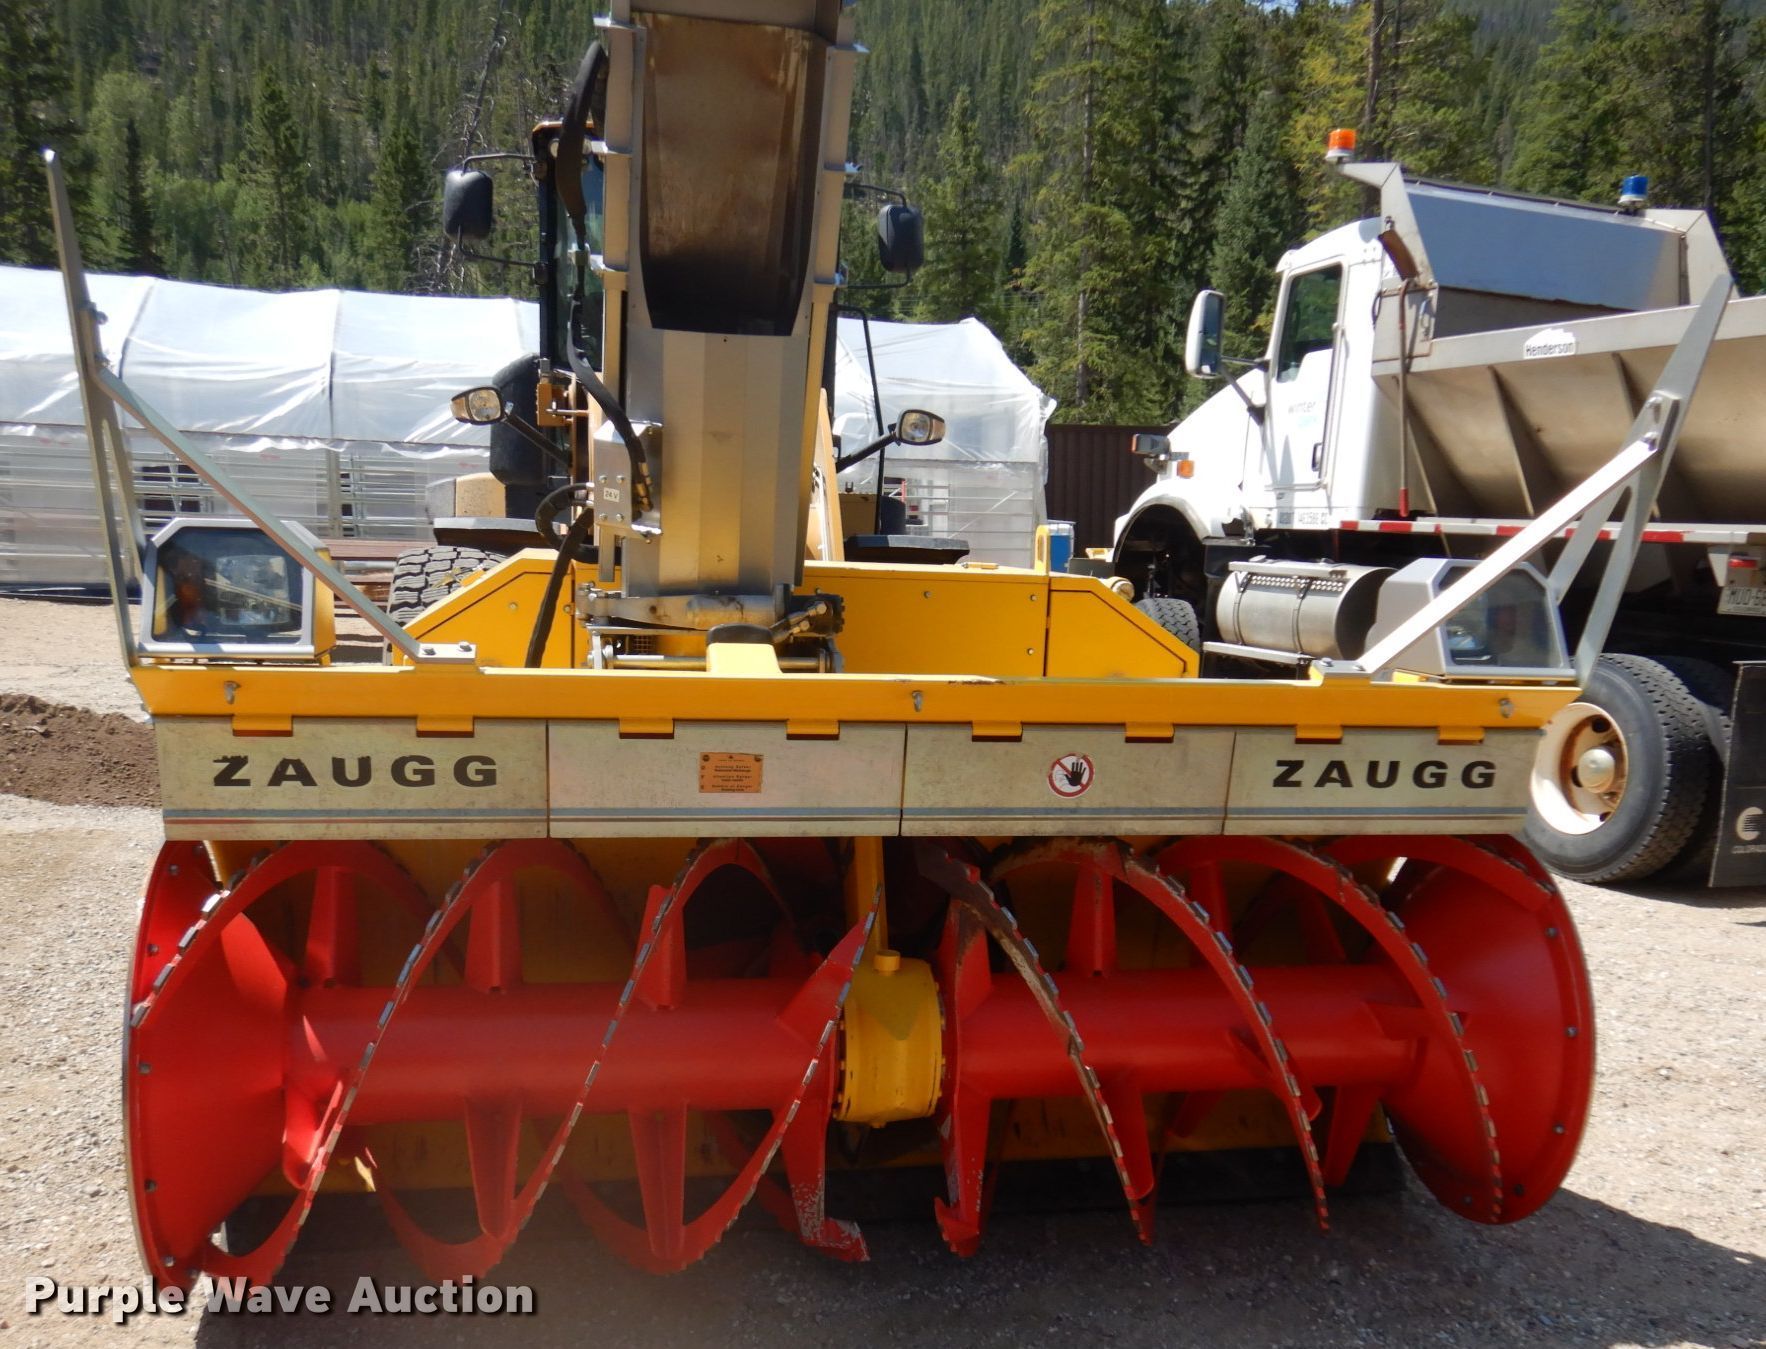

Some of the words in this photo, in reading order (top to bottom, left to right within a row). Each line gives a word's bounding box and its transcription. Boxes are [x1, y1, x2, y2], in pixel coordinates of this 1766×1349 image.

[1526, 342, 1574, 357] Henderson
[213, 755, 497, 788] ZAUGG
[1272, 759, 1497, 789] ZAUGG
